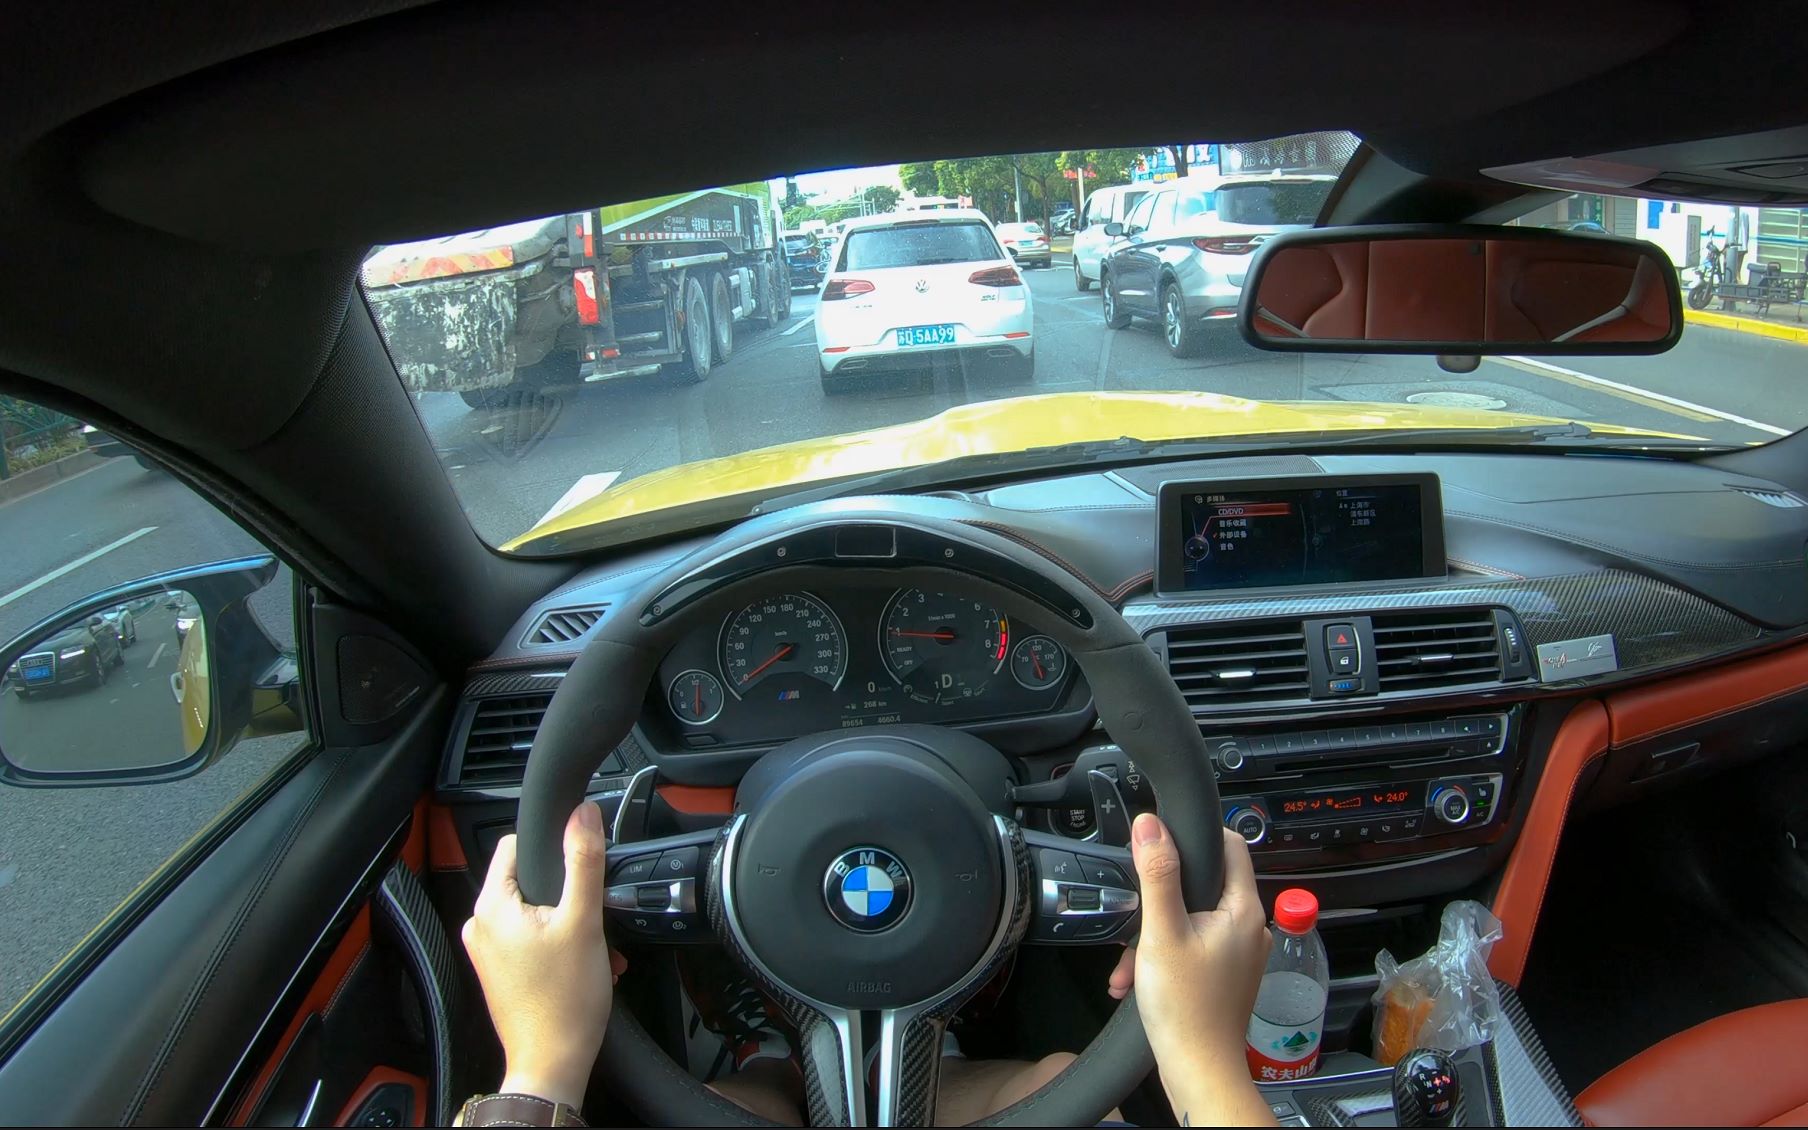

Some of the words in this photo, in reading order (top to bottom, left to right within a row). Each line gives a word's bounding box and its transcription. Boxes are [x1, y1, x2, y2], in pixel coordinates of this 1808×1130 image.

[1218, 507, 1244, 516] CD/DVD
[1219, 530, 1248, 539] 外部设备
[918, 593, 925, 603] 3
[763, 605, 777, 614] 150
[780, 603, 794, 612] 180
[974, 602, 981, 611] 6
[795, 609, 809, 618] 210
[902, 607, 909, 617] 2
[748, 614, 762, 623] 120
[807, 620, 821, 628] 240
[984, 619, 990, 629] 7
[739, 627, 749, 635] 90
[815, 633, 830, 642] 270
[984, 639, 991, 648] 8
[817, 649, 832, 658] 300
[735, 659, 746, 667] 30
[813, 665, 829, 674] 330
[941, 673, 953, 689] D
[867, 681, 876, 693] 0
[834, 851, 907, 886] BMW
[847, 981, 892, 993] AIRBAG
